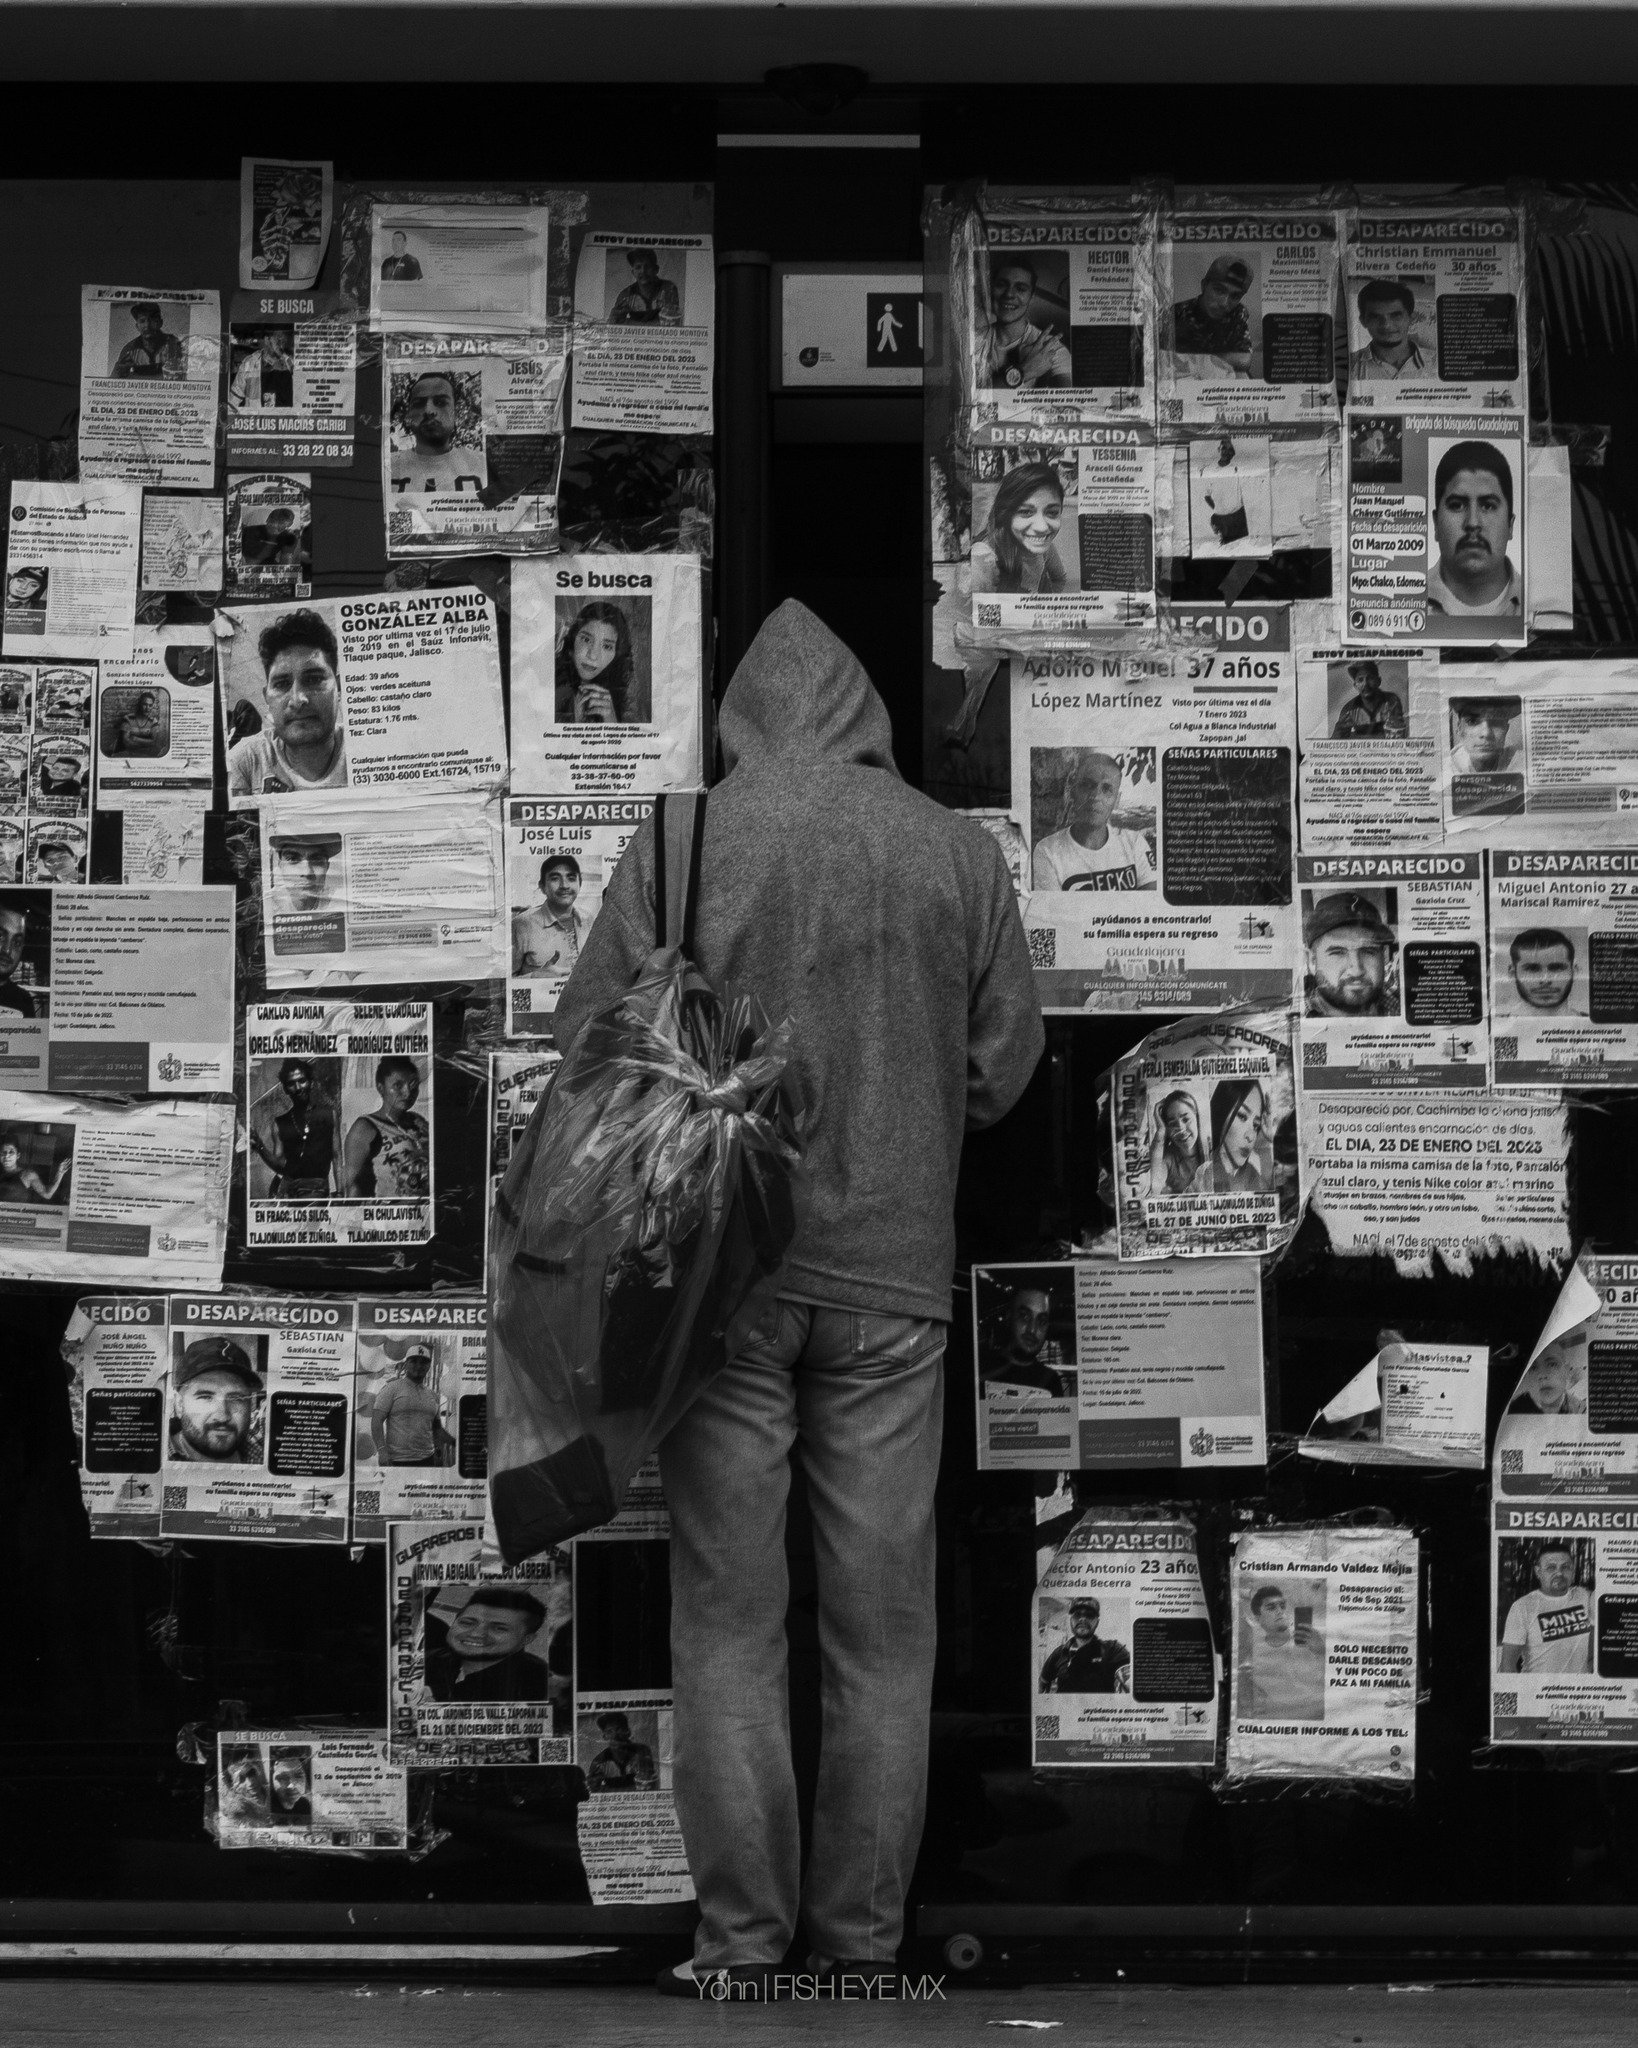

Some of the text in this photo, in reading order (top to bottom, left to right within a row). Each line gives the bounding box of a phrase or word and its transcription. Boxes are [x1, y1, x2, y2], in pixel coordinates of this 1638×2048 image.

[987, 227, 1133, 243] DESAPARECIDO
[1173, 223, 1322, 240] DESAPARECIDO
[1362, 223, 1504, 238] DESAPARECIDO
[594, 236, 702, 246] ESTOY DESAPARECIDO
[1356, 246, 1496, 258] Christian Emmanuel
[1356, 262, 1436, 271] Rivera Cedeño
[1452, 261, 1496, 272] 30 años
[260, 299, 314, 313] SE BUSCA
[508, 361, 542, 375] JESÚS
[232, 416, 346, 431] JOSÉ LUIS MACIAS GARIBI
[990, 428, 1140, 445] DESAPARECIDA
[283, 444, 295, 456] 33
[298, 445, 309, 456] 28
[312, 445, 324, 456] 22
[327, 445, 338, 456] 08
[341, 445, 353, 457] 34
[1092, 449, 1137, 462] YESSENIA
[1353, 484, 1385, 493] Nombre
[1353, 497, 1404, 506] Juan Manuel
[1353, 540, 1424, 550] 01 Marzo 2009
[1352, 557, 1388, 570] Lugar
[556, 571, 652, 589] Se busca
[341, 594, 486, 617] OSCAR ANTONIO
[342, 609, 488, 632] GONZÁLEZ ALBA
[1368, 613, 1408, 627] 089 ó 911
[342, 635, 364, 643] Visto
[368, 635, 382, 644] por
[386, 631, 413, 640] ultima
[471, 625, 490, 634] julio
[1187, 657, 1280, 678] 37 años
[346, 674, 367, 682] Edad:
[1032, 692, 1162, 712] López Martínez
[1169, 747, 1277, 758] SEÑAS PARTICULARES
[353, 764, 501, 785] (33) 3030-6000 Ext.16724, 15719
[521, 804, 653, 821] DESAPARECID
[520, 825, 591, 844] José Luis
[529, 846, 582, 855] Valle Soto
[1312, 858, 1466, 877] DESAPARECIDO
[1408, 881, 1472, 893] SEBASTIAN
[1498, 881, 1627, 895] Miguel Antonio 27
[1501, 897, 1549, 908] Mariscal
[1084, 928, 1218, 940] su familia espera su regreso
[1326, 1138, 1542, 1154] EL DIA, 23 DE ENERO DEL 2023
[1322, 1176, 1344, 1187] azul
[1348, 1176, 1380, 1189] claro,
[1383, 1179, 1389, 1190] y
[1392, 1177, 1421, 1188] tenis
[1424, 1177, 1451, 1189] Nike
[1454, 1177, 1482, 1188] color
[1513, 1179, 1554, 1189] marino
[364, 1208, 424, 1221] EN CHULAVISTA,
[1149, 1213, 1276, 1227] EL 27 DE JUNIO DEL 2023
[186, 1304, 339, 1324] DESAPARECIDO
[374, 1308, 487, 1324] DESAPAREC
[280, 1331, 344, 1343] SEBASTIAN
[1087, 1562, 1136, 1575] Antonio
[1140, 1559, 1160, 1575] 23
[1239, 1561, 1283, 1571] Cristian
[1287, 1562, 1338, 1572] Armando
[1341, 1563, 1379, 1573] Valdez
[1042, 1577, 1131, 1590] Quezada Becerra
[421, 1723, 543, 1735] EL 21 DE DICIEMBRE DEL 2023
[1238, 1725, 1408, 1738] CUALQUIER INFORME A LOS TEL:
[236, 1732, 286, 1742] SE BUSCA
